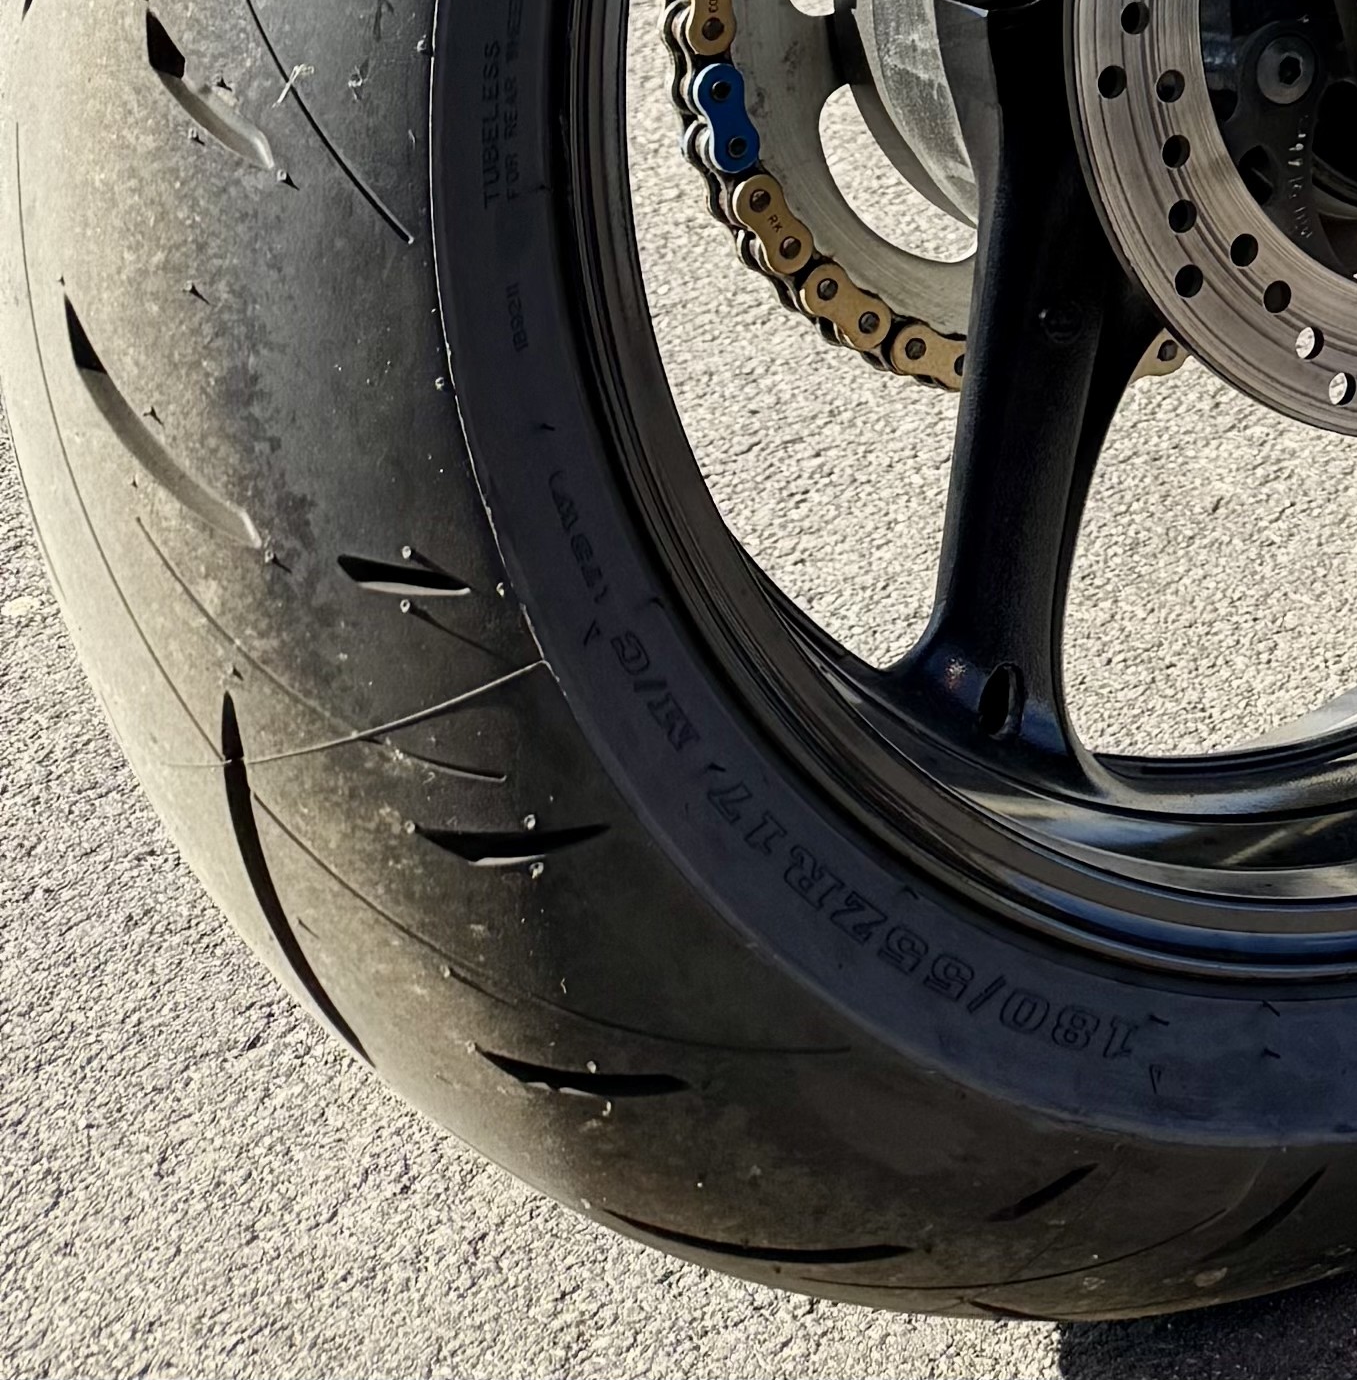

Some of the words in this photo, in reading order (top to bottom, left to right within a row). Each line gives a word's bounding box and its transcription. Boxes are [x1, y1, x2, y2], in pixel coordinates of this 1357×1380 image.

[481, 39, 502, 209] TUBELESS
[610, 629, 700, 754] M/C
[706, 773, 1139, 1061] 180/55ZR17
